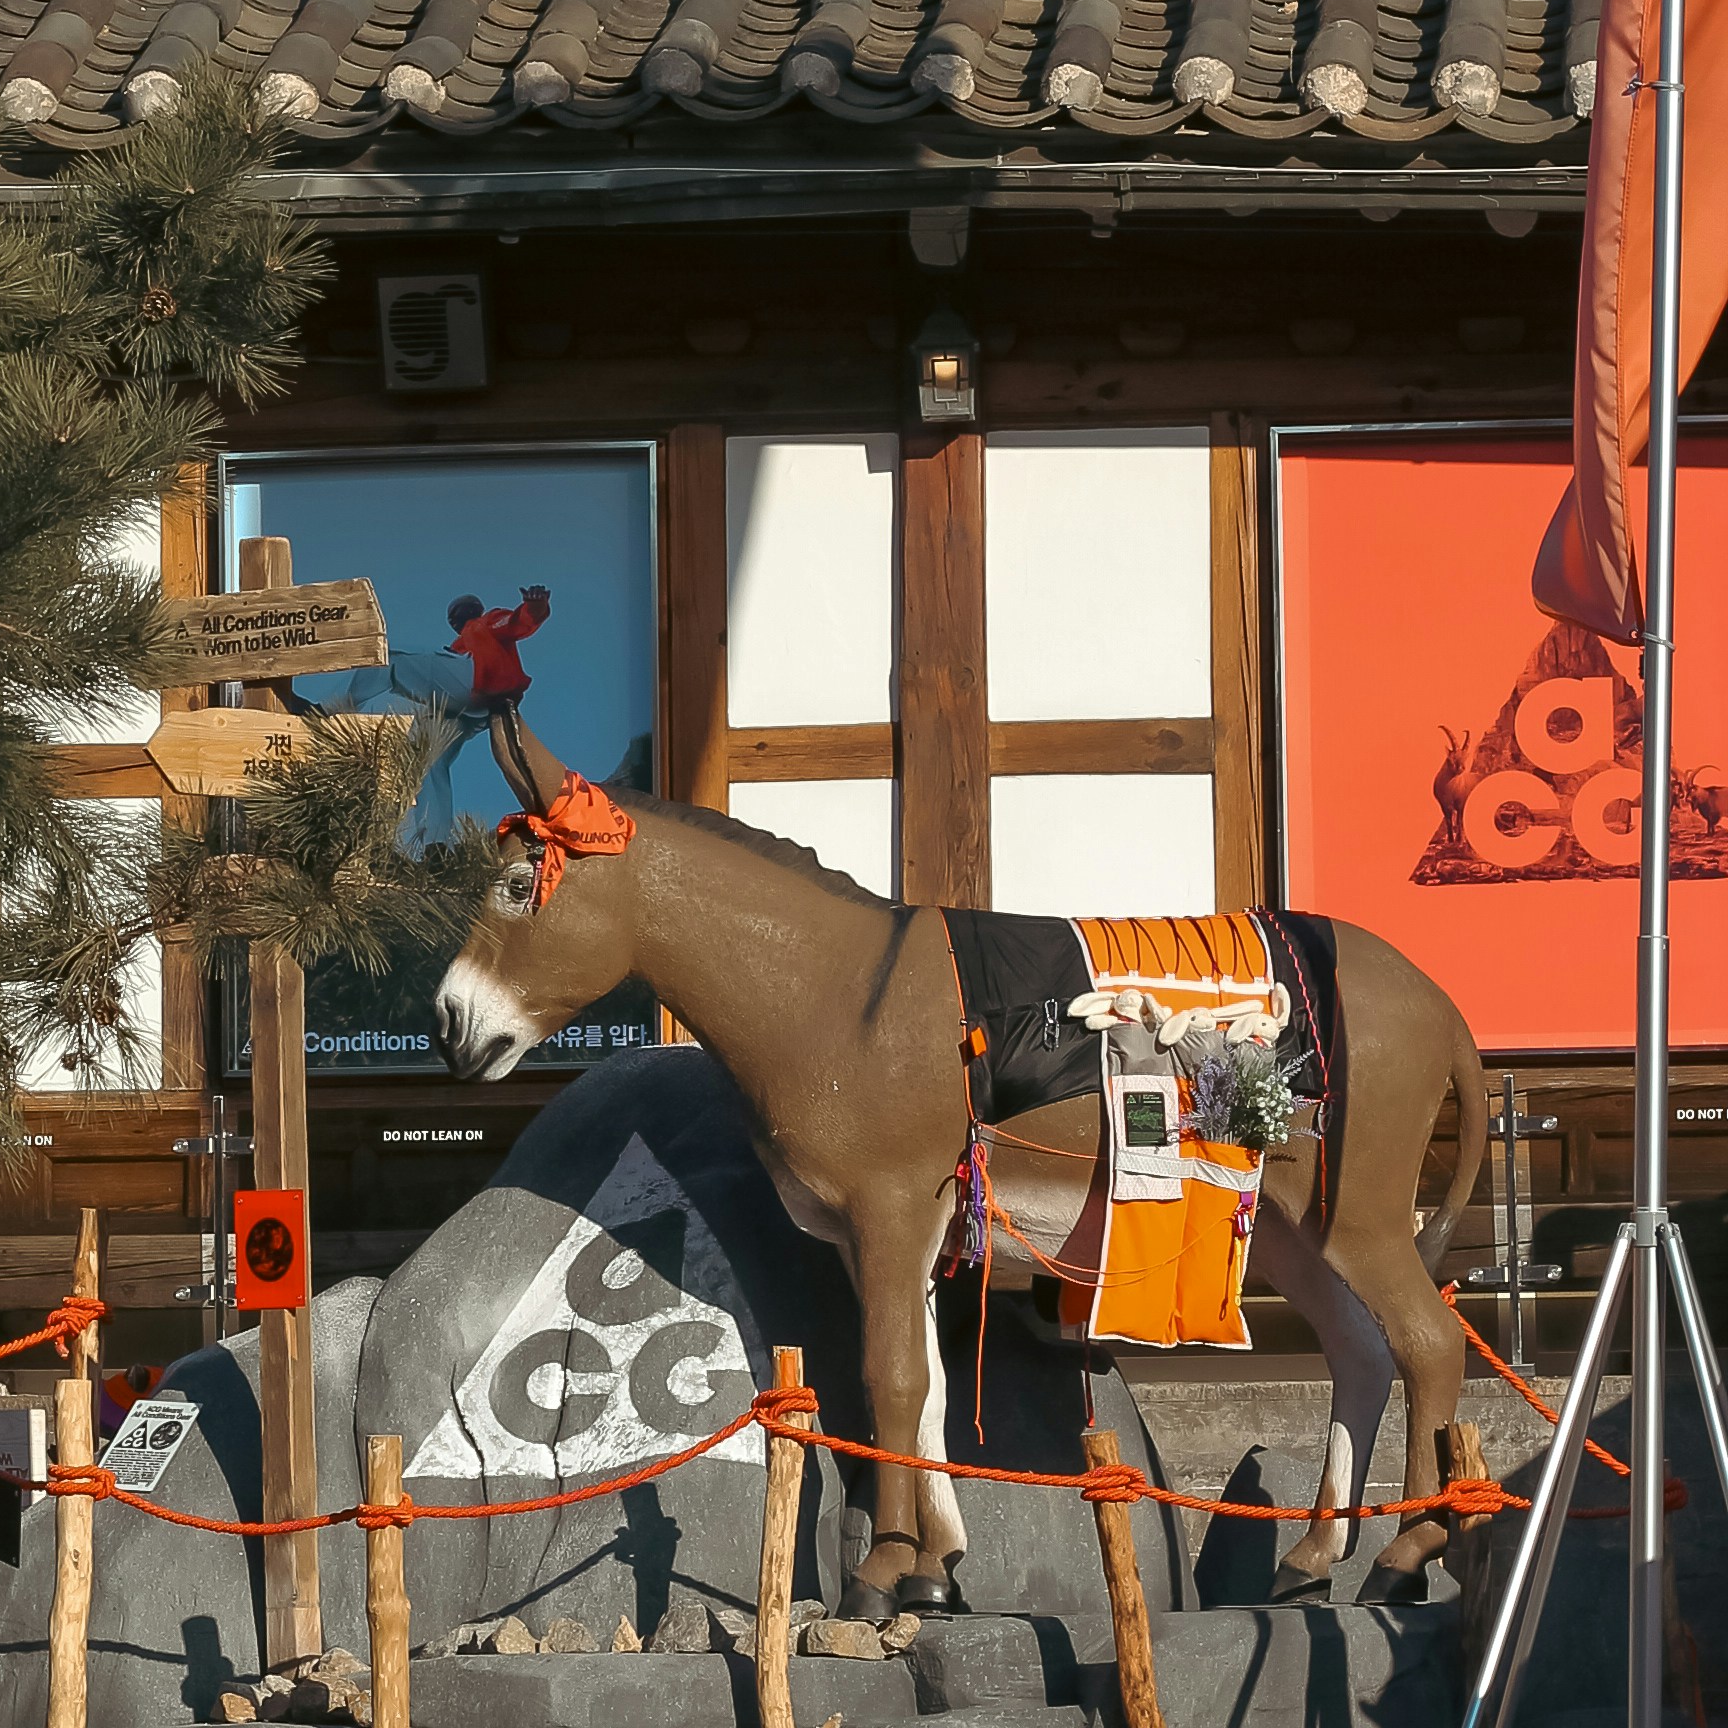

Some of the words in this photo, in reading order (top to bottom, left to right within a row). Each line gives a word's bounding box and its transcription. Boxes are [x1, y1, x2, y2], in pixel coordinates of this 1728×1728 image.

[202, 615, 221, 634] All
[223, 608, 306, 633] Conditions
[309, 604, 351, 622] Gear.
[245, 635, 261, 652] to
[261, 632, 282, 650] be
[284, 626, 320, 647] Wild.
[265, 734, 292, 756] 거친
[304, 1031, 430, 1052] Conditions
[1676, 1109, 1695, 1120] DO
[1697, 1109, 1724, 1120] NOT
[34, 1135, 53, 1146] ON
[383, 1130, 401, 1141] DO
[403, 1130, 429, 1141] NOT
[431, 1130, 463, 1141] LEAN
[465, 1130, 483, 1141] ON
